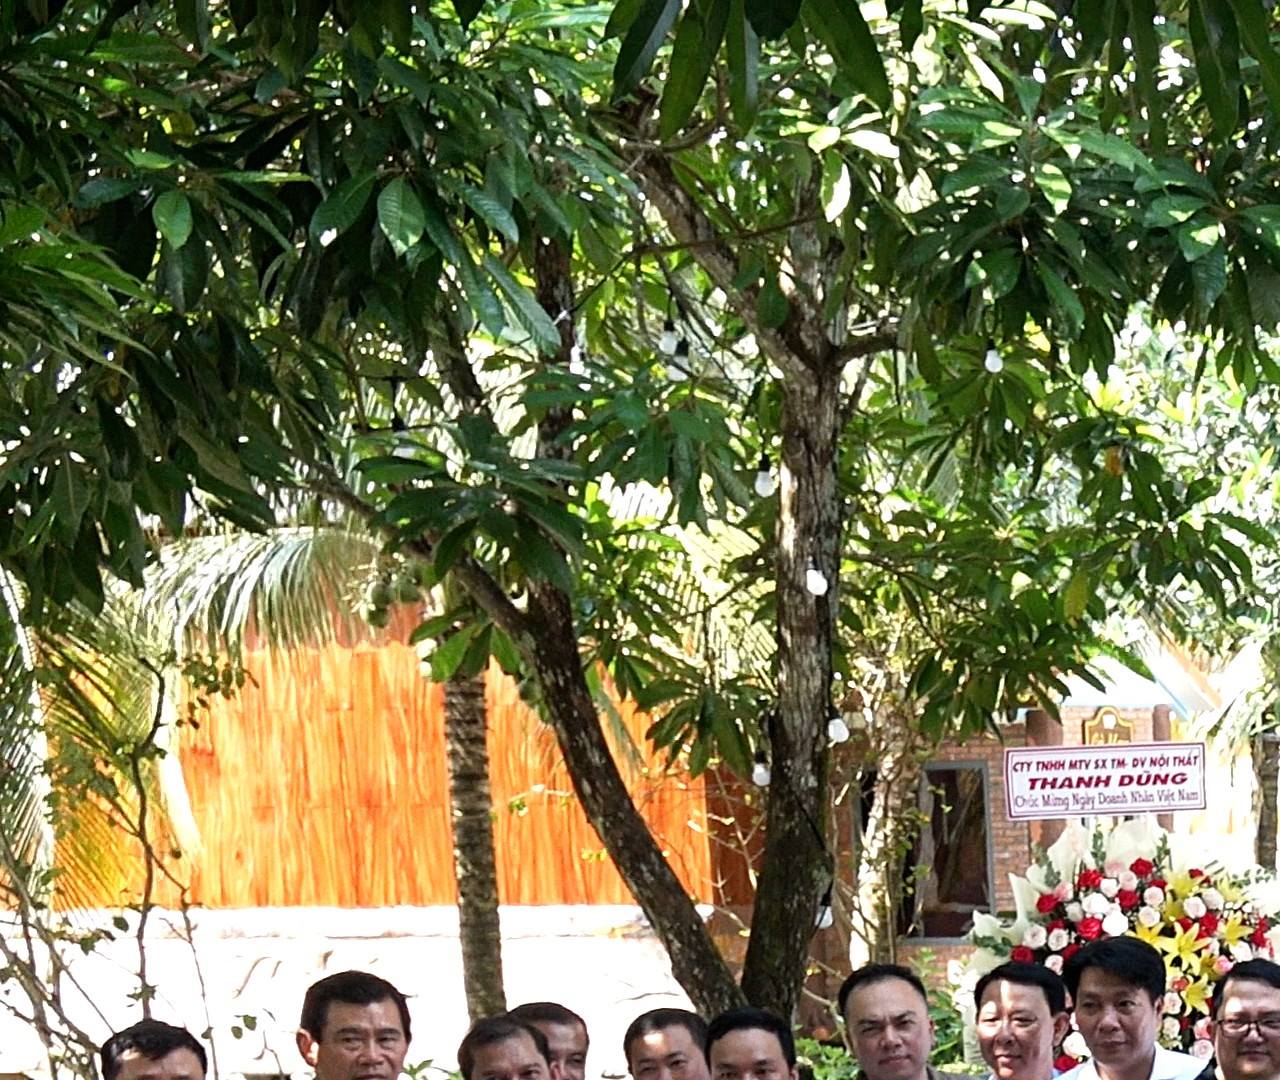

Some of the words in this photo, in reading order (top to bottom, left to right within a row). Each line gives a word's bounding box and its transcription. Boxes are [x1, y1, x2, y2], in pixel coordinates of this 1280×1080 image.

[1013, 761, 1032, 772] CTY
[1036, 760, 1065, 771] TNHH
[1069, 759, 1092, 770] MTV
[1094, 758, 1108, 769] SX
[1132, 756, 1147, 768] DV
[1029, 775, 1112, 790] THANH
[1118, 770, 1188, 787] DŨNG
